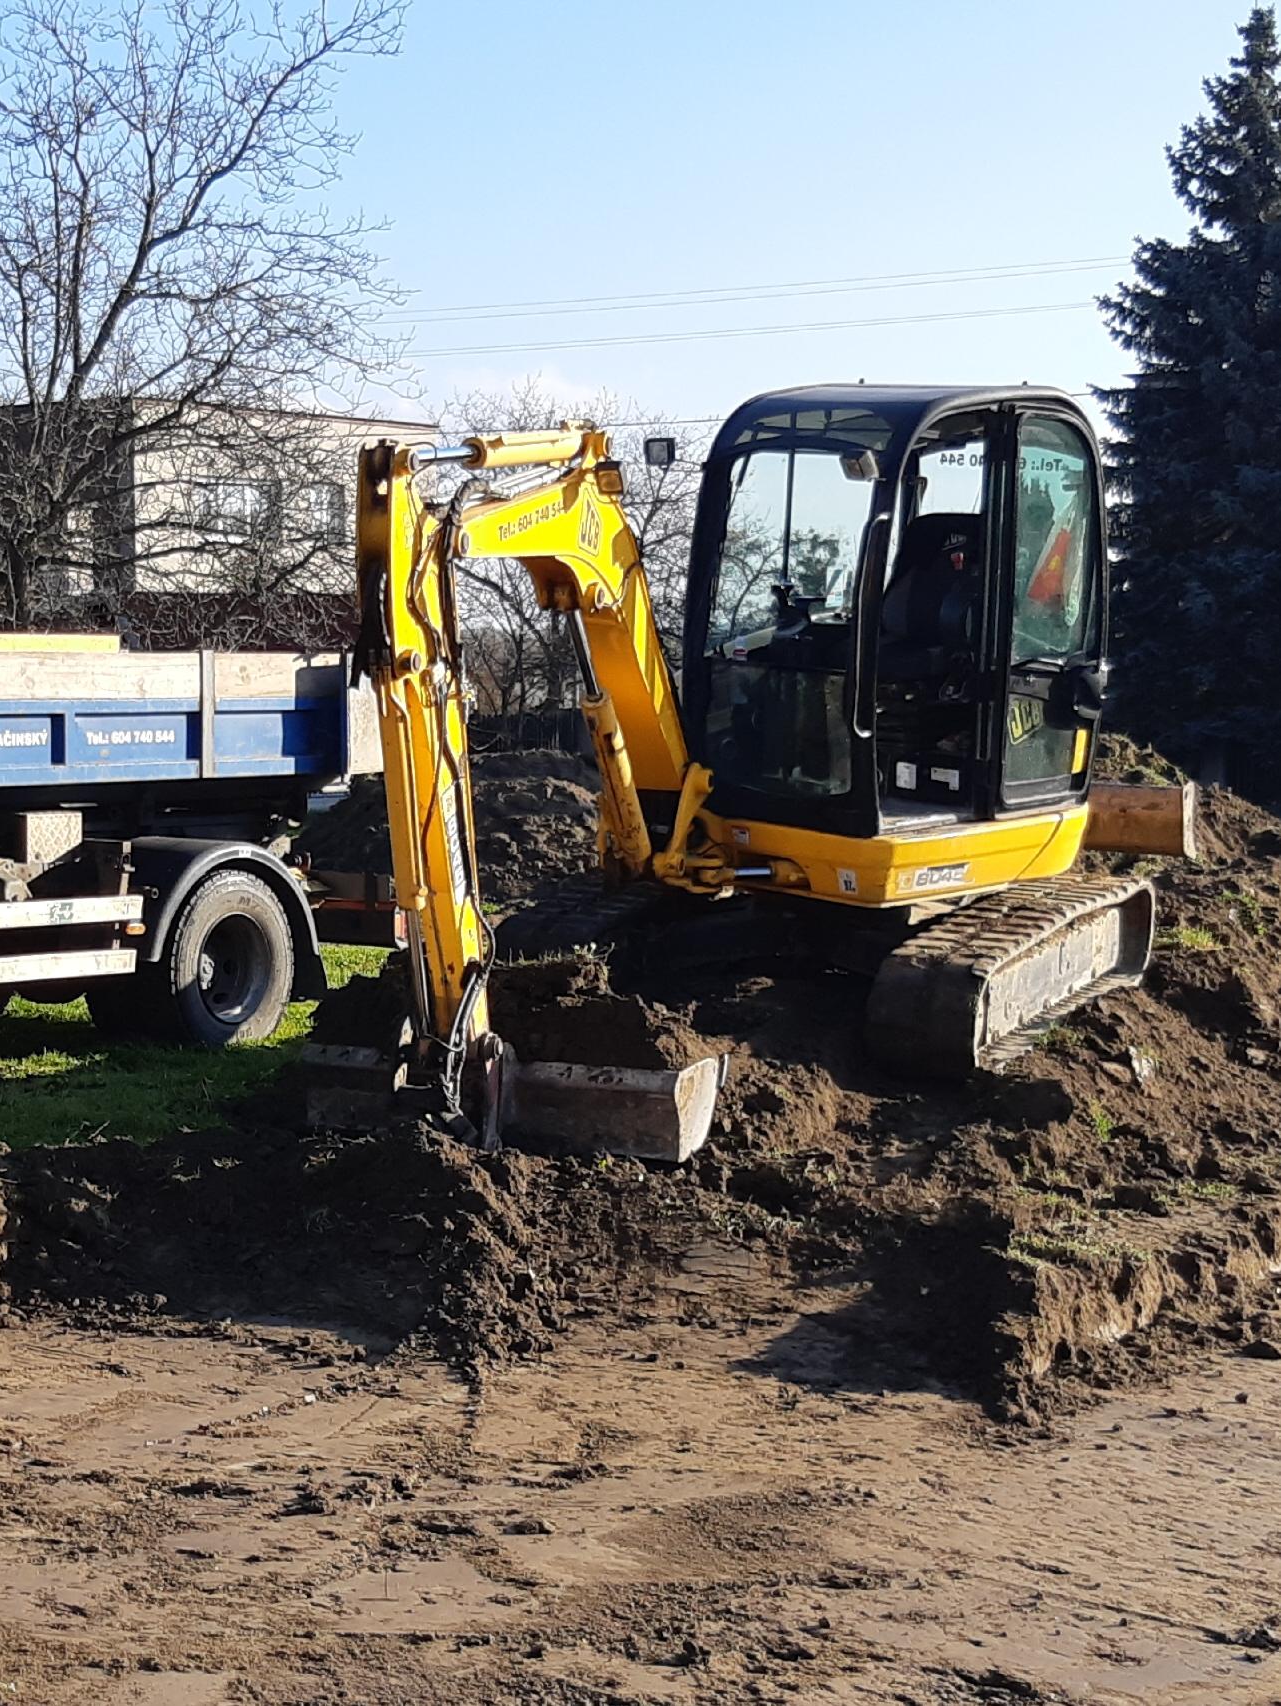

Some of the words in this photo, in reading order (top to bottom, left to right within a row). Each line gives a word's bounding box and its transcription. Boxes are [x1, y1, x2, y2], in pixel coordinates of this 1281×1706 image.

[498, 522, 516, 541] Tel.:
[518, 514, 533, 532] 604
[535, 505, 550, 525] 740
[580, 499, 600, 550] JCB
[86, 730, 109, 745] Tel.:
[111, 730, 132, 744] 604
[133, 730, 153, 743] 740
[155, 729, 175, 743] 544
[1011, 700, 1040, 739] JCB
